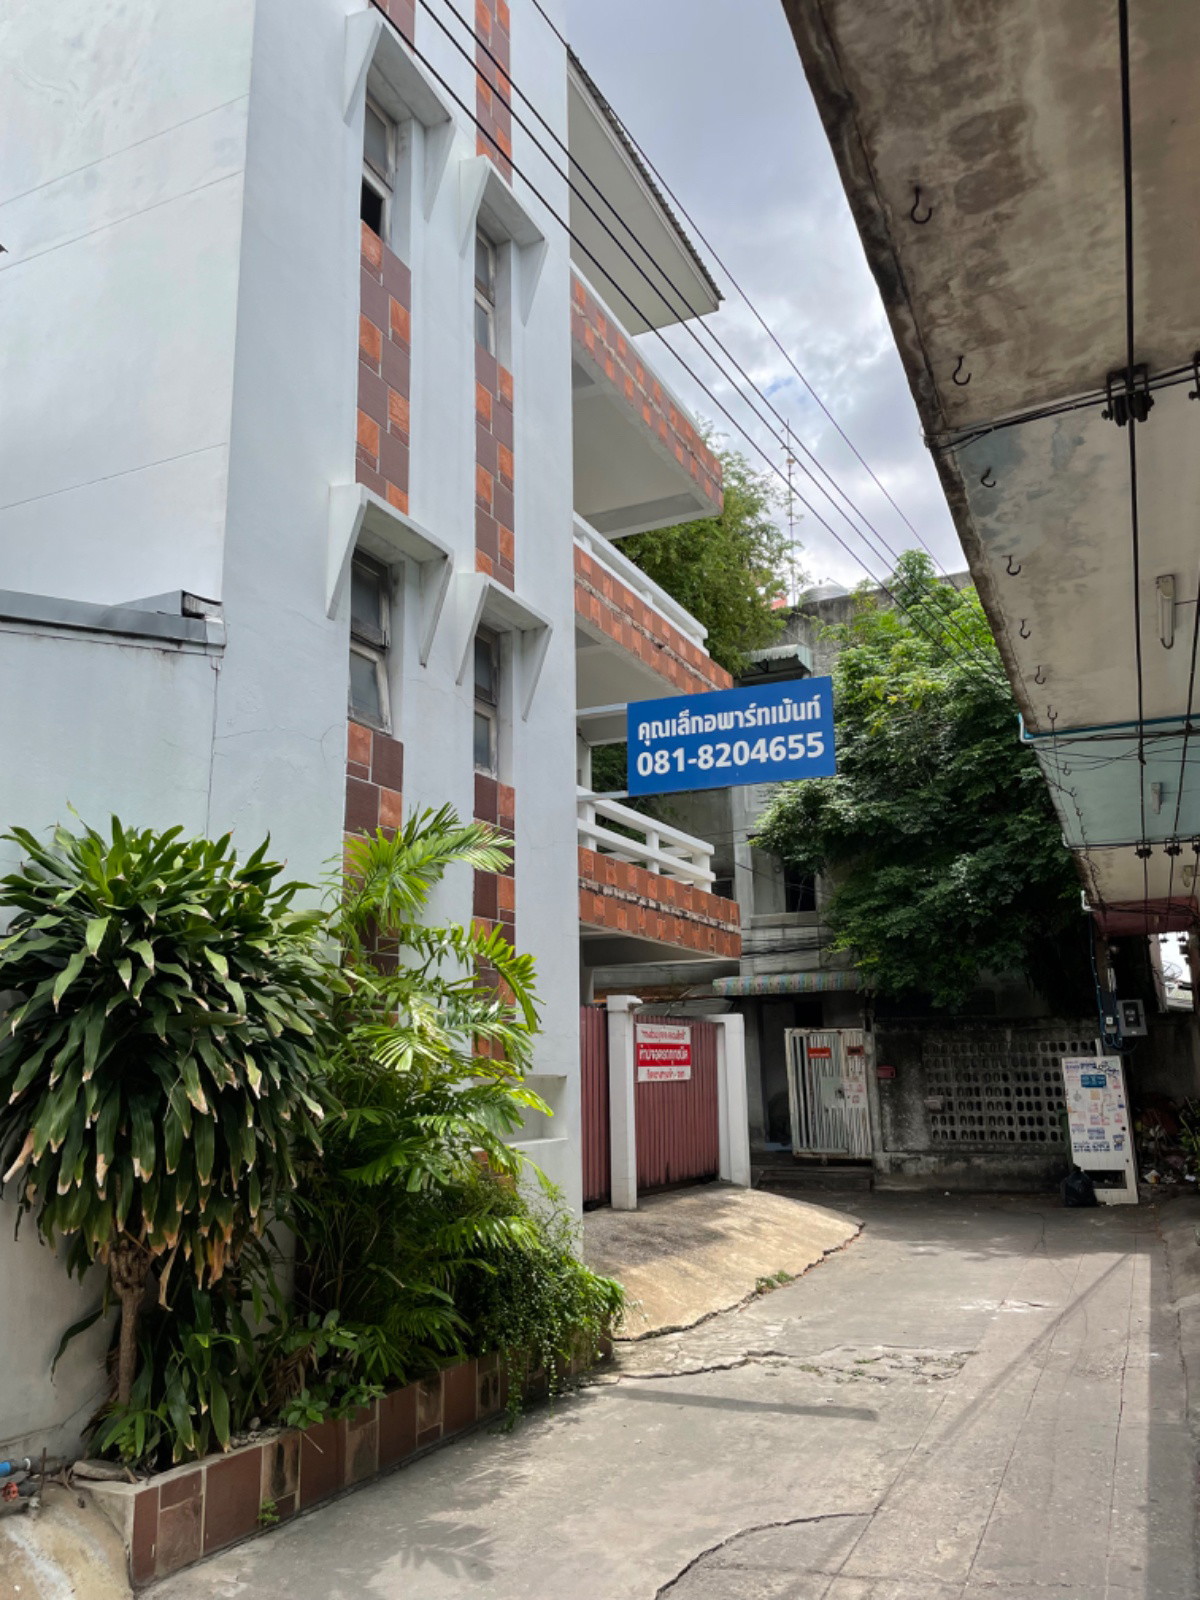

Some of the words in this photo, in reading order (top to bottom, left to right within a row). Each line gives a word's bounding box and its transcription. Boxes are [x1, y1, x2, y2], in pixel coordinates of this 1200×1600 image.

[638, 694, 821, 747] คุณเล็กอพาร์ทเม้นท์
[636, 731, 825, 777] 081-8204655
